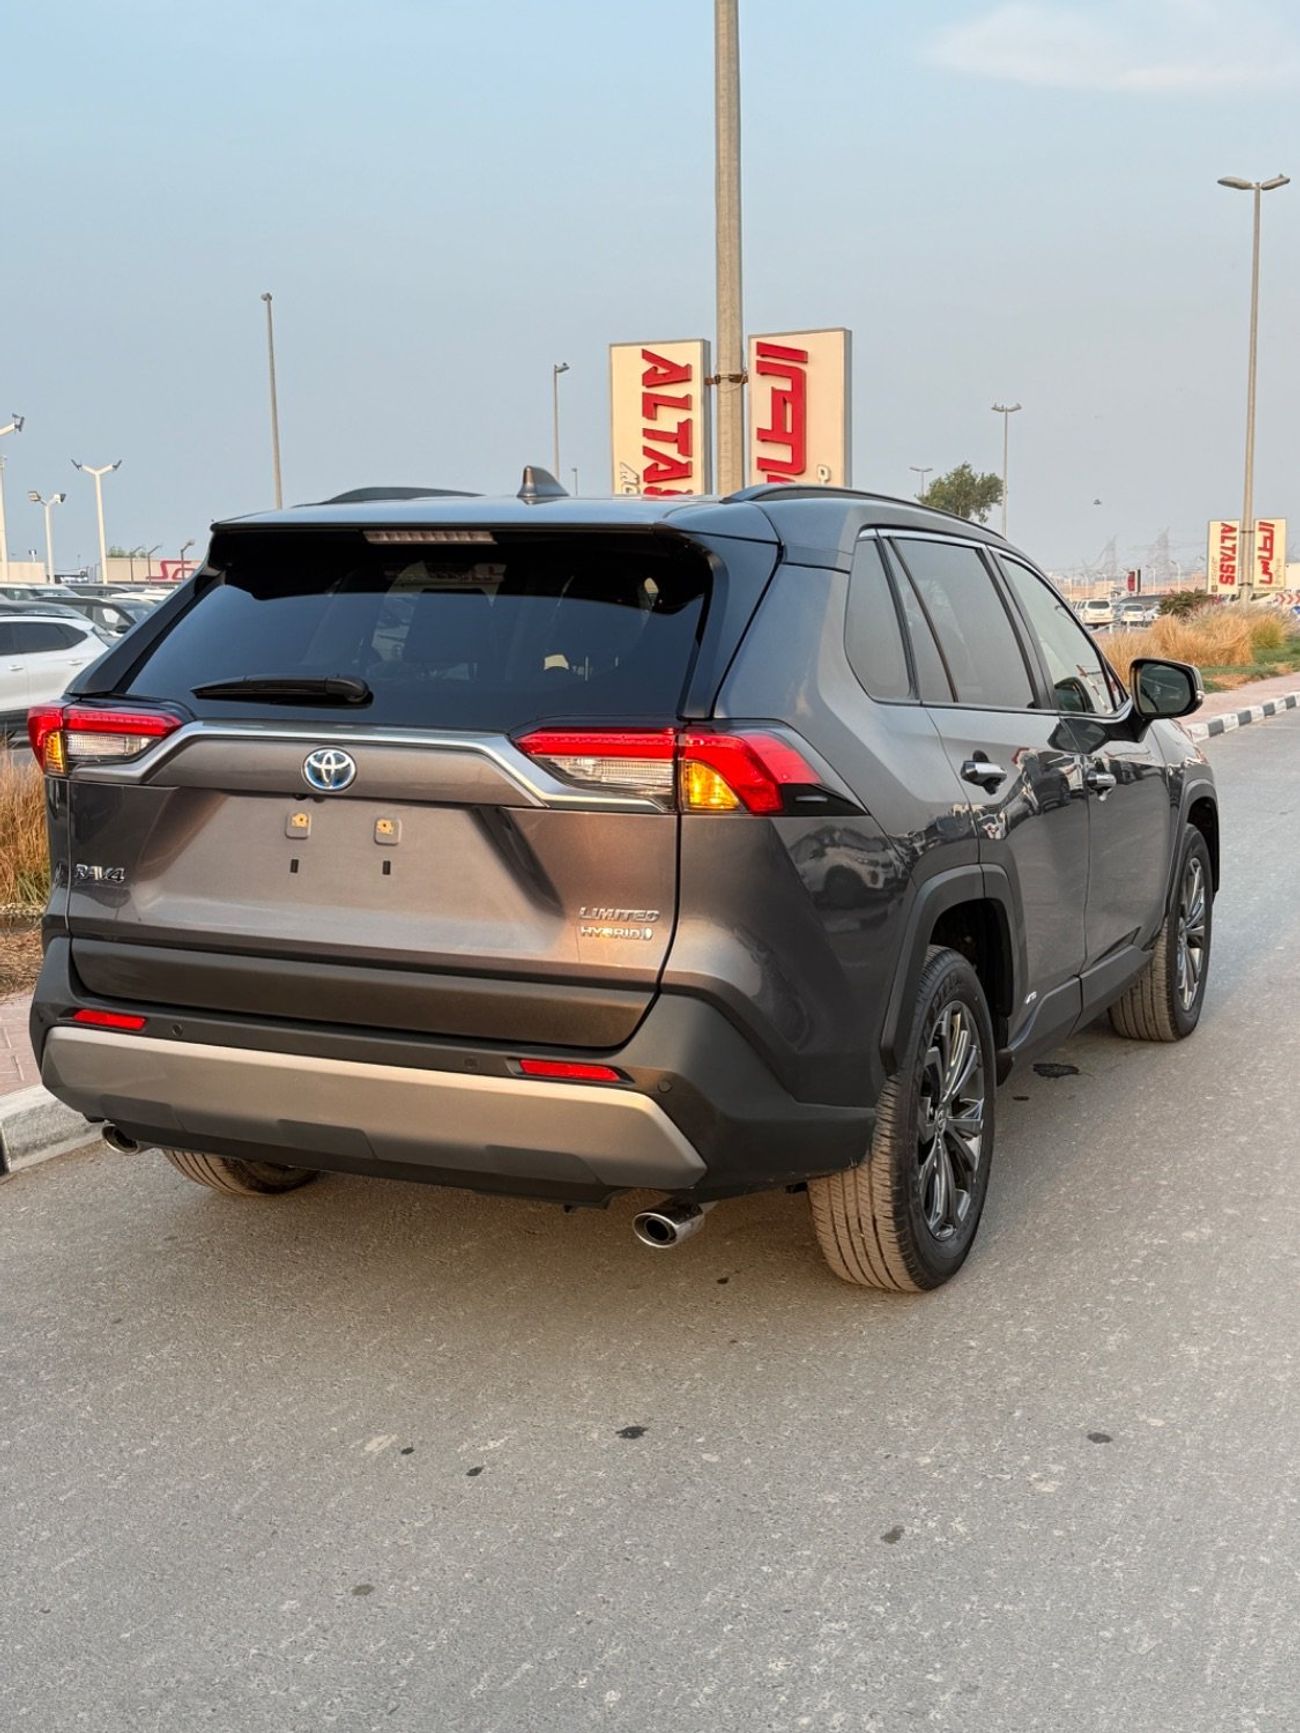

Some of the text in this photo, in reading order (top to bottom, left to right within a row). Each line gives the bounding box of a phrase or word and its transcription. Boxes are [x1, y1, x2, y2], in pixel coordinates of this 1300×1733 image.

[756, 341, 808, 483] الطا
[1219, 522, 1237, 585] ALTASS
[75, 863, 125, 883] RAV4
[579, 906, 660, 923] LIMITED
[580, 926, 641, 940] HYBRID
